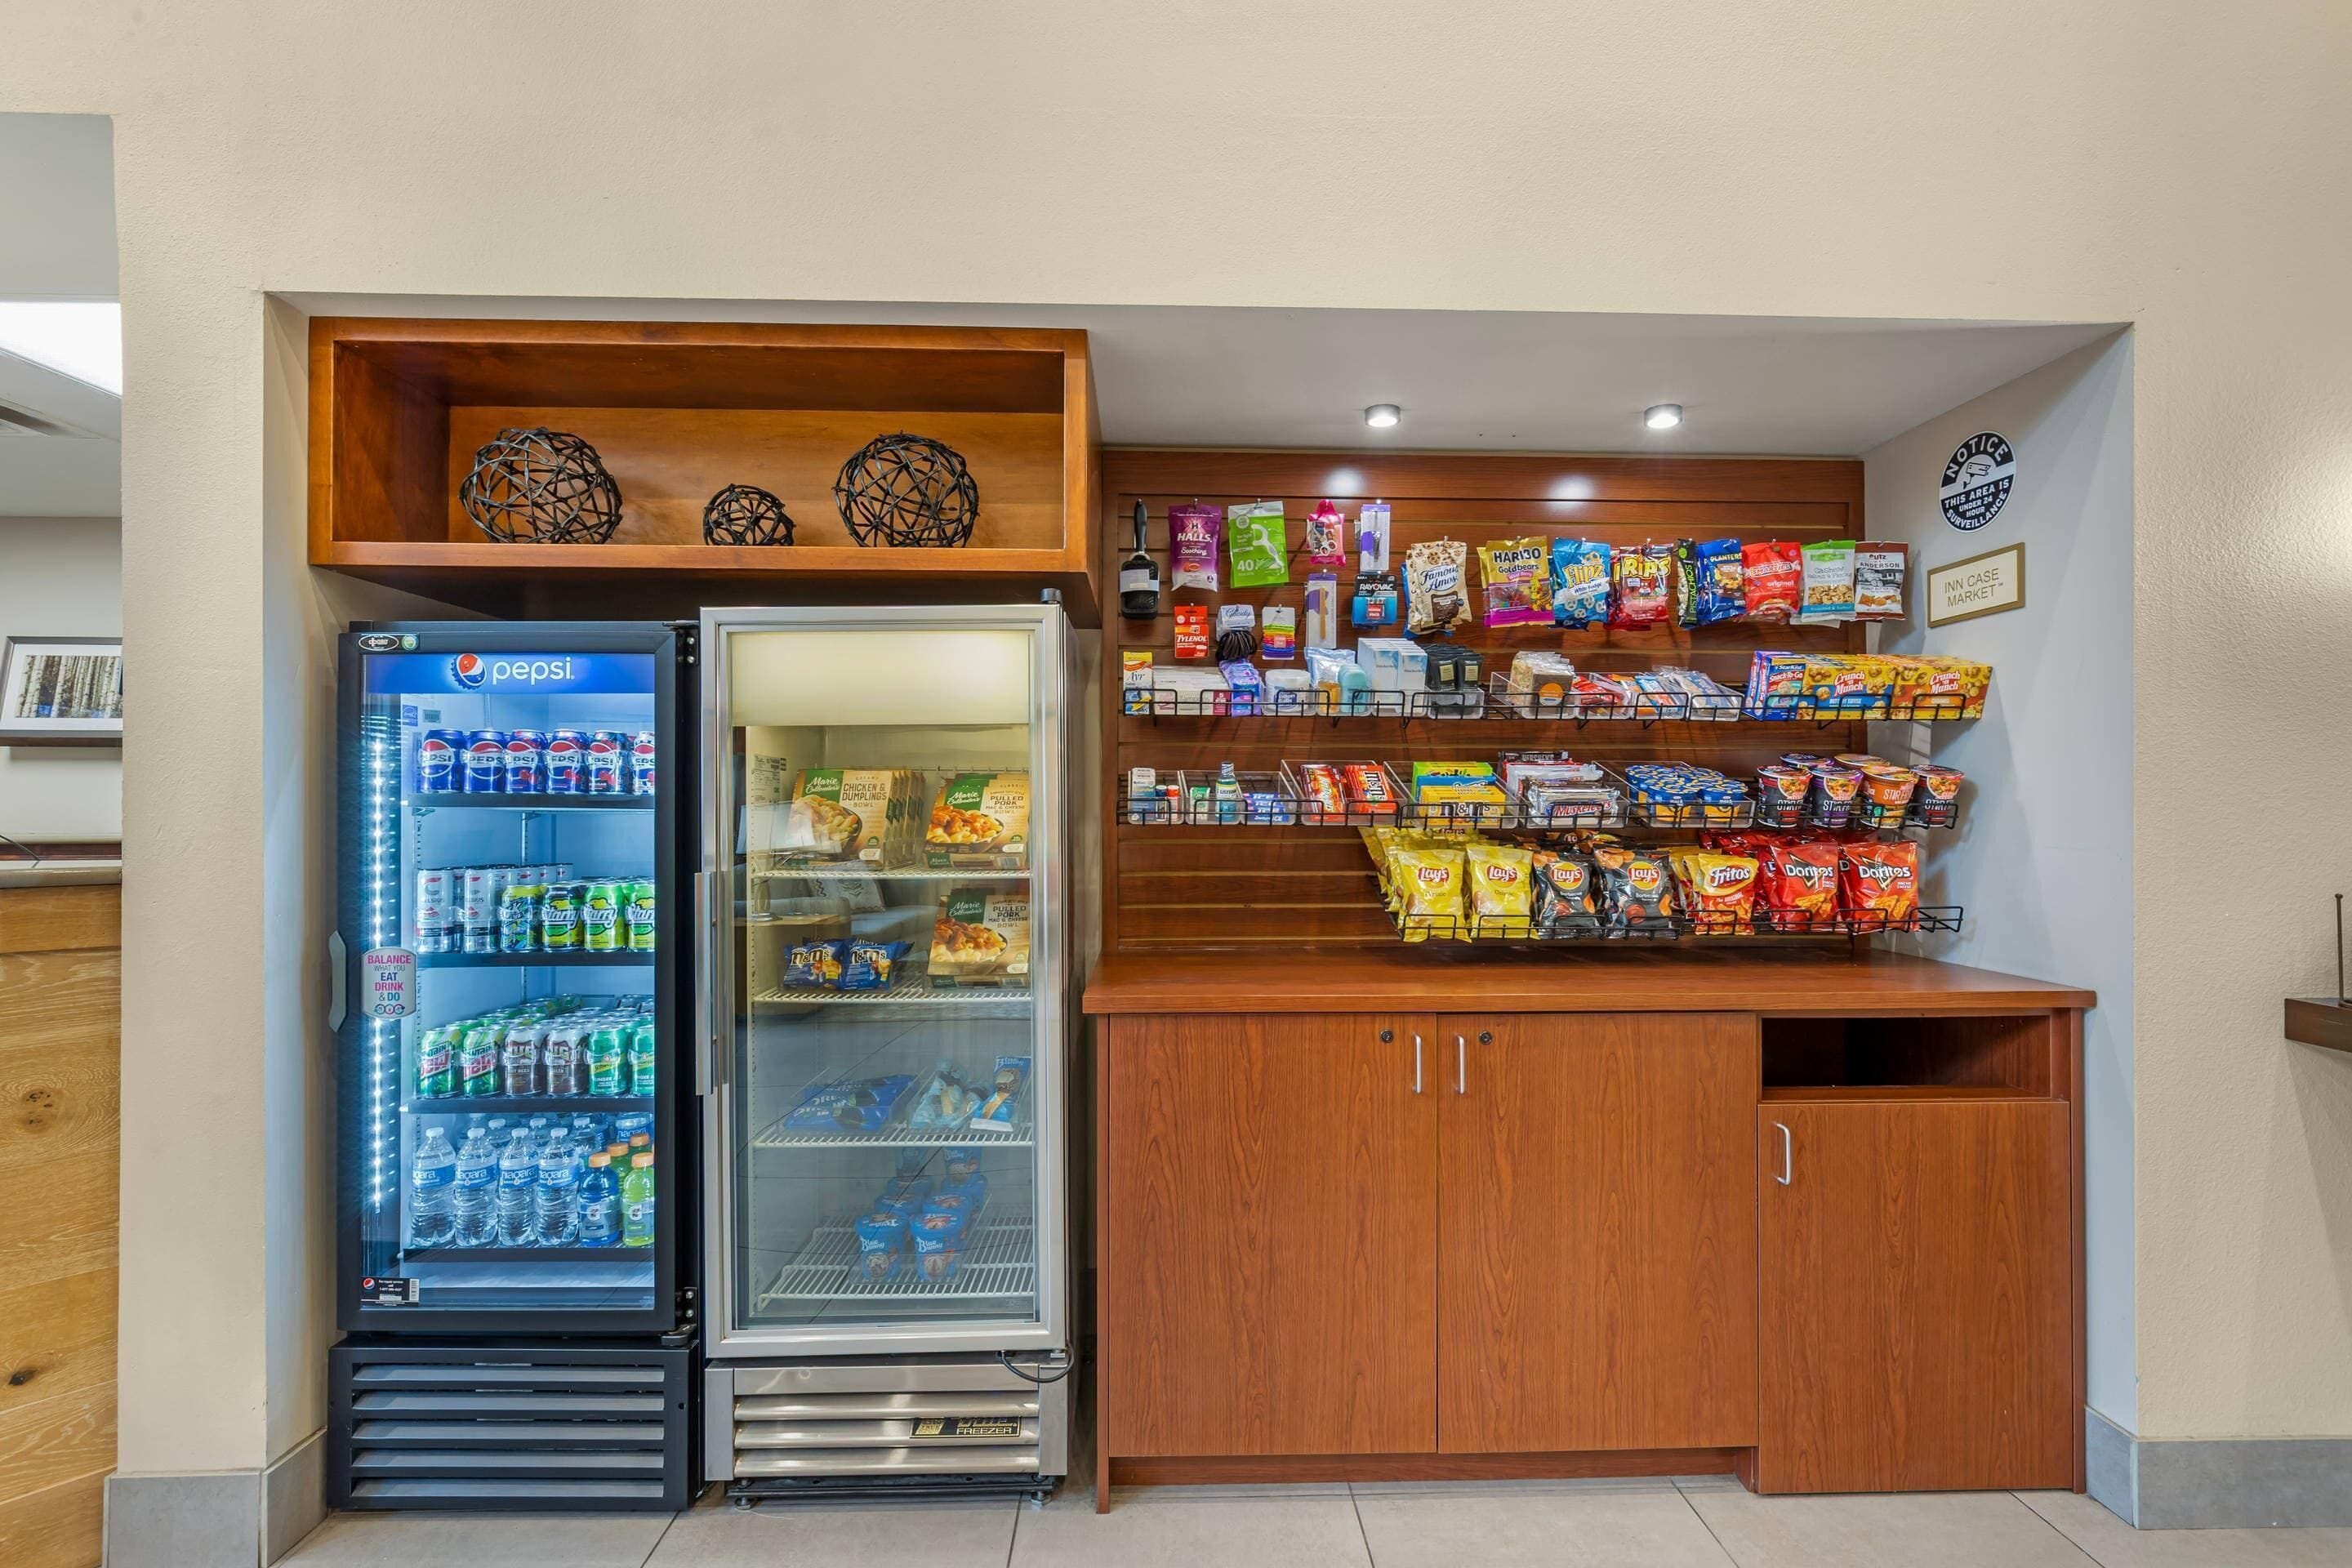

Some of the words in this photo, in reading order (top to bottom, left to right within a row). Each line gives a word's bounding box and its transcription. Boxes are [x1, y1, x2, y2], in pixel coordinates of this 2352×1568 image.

[1946, 435, 2008, 478] NOTICE
[1944, 494, 1966, 508] THIS
[1969, 484, 1995, 500] AREA
[1999, 479, 2009, 490] IS
[1946, 491, 2007, 528] SURVEILLANCE
[1959, 500, 1981, 512] UNDER
[1983, 497, 1993, 506] 24
[1966, 506, 1985, 518] HOUR
[1177, 532, 1211, 541] HALLS
[1181, 546, 1208, 556] Soothing
[1494, 548, 1541, 563] HARIBO
[1710, 553, 1743, 562] PLANTERS
[1237, 559, 1254, 571] 40
[1499, 564, 1539, 573] Goldbears
[1623, 556, 1672, 578] Rips
[1562, 564, 1604, 589] Flipz
[1944, 577, 1963, 595] INN
[1967, 568, 1999, 587] CASE
[1686, 564, 1696, 612] PISTACHIOS
[1947, 584, 1996, 608] MARKET
[1177, 635, 1206, 643] TYLENOL
[492, 657, 572, 686] pepsi
[1834, 670, 1865, 684] Crunch
[1930, 670, 1960, 685] Crunch
[1834, 682, 1864, 696] Munch
[1931, 681, 1958, 694] Munch
[469, 755, 503, 764] PEPS
[807, 777, 838, 786] Marie
[844, 783, 877, 792] CHICKEN
[880, 783, 885, 791] &
[842, 792, 887, 801] DUMPLINGS
[950, 791, 979, 800] Marie
[1553, 801, 1612, 817] Musketees
[1419, 866, 1448, 883] Lay's
[1488, 865, 1517, 882] Lay's
[1553, 868, 1582, 883] Lay's
[1631, 868, 1659, 884] Lay's
[1710, 866, 1752, 887] Fritos
[1785, 864, 1833, 877] Doritos
[1860, 866, 1912, 879] Doritos
[952, 901, 981, 910] Marie
[581, 902, 617, 929] Starry
[368, 955, 412, 964] BALANCE
[381, 972, 398, 981] EAT
[375, 982, 404, 991] DRINK
[379, 992, 385, 1001] &
[387, 992, 400, 1001] DO
[455, 1169, 487, 1186] niagara
[501, 1168, 535, 1185] niagara
